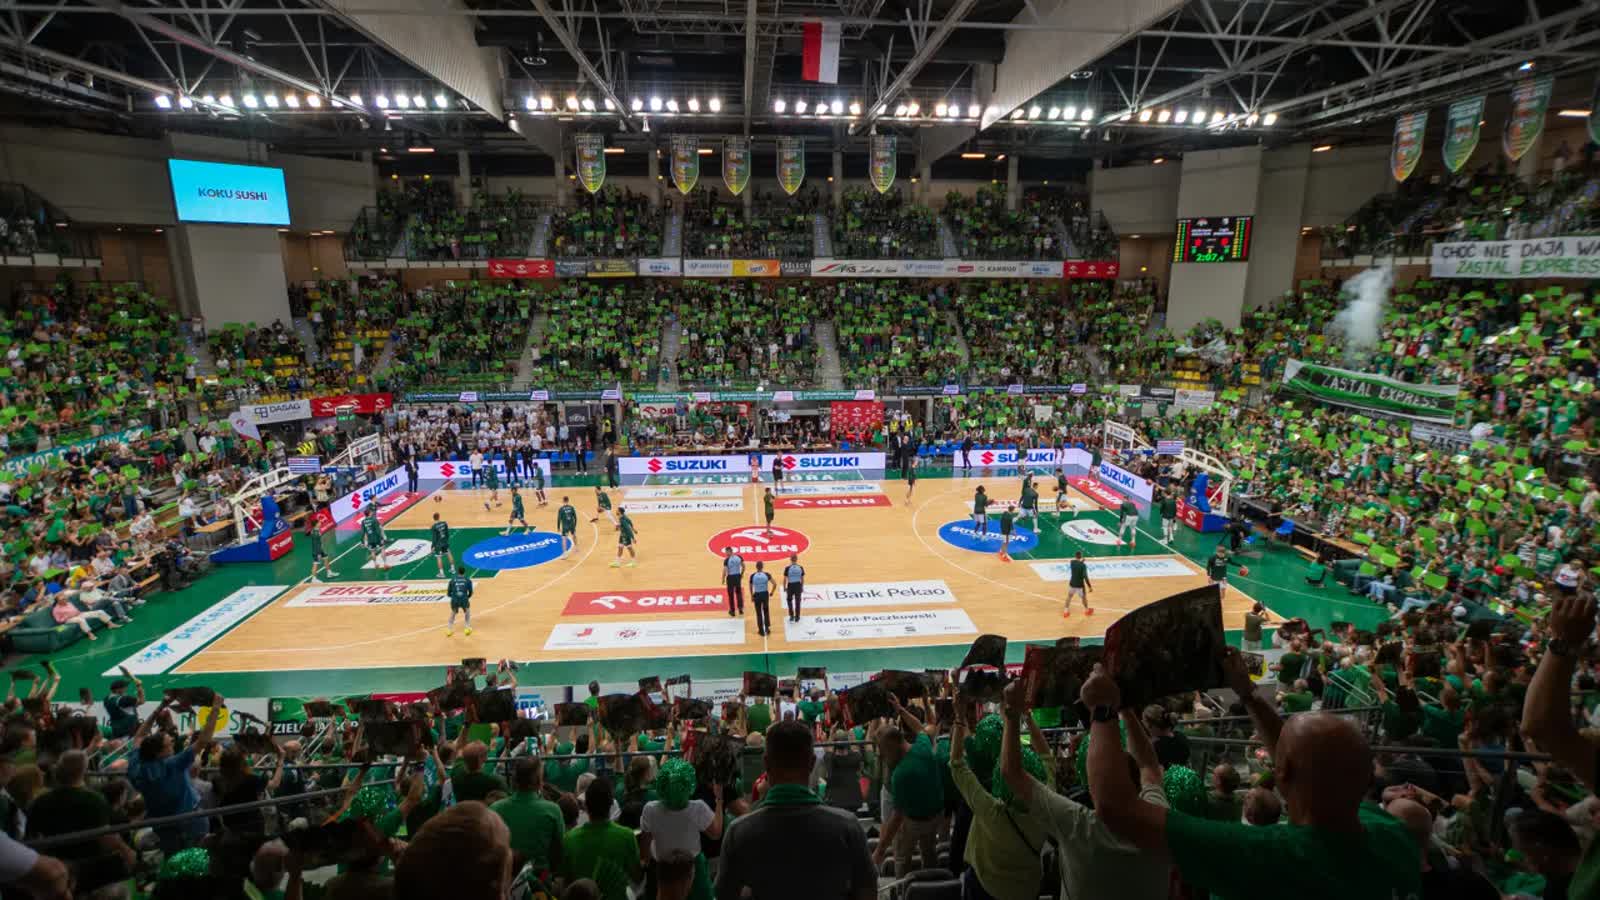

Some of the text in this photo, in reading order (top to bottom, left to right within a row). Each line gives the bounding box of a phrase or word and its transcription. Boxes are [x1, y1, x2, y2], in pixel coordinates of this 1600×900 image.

[198, 187, 268, 200] KOKU SUSHI
[1483, 244, 1512, 258] NIE
[1455, 256, 1600, 274] ZASTAL EXPRESS
[1321, 374, 1440, 409] ZASTAL EXPRESS
[269, 404, 300, 414] DASAG
[799, 456, 859, 468] SUZUKI
[997, 452, 1054, 464] SUUKI
[666, 459, 727, 471] SUZUKI
[1100, 463, 1136, 490] SUZUKI
[362, 475, 399, 503] SUZUKI
[816, 498, 876, 506] ORLEN
[473, 537, 559, 560] Streamsoft
[320, 584, 408, 596] BRICO
[834, 585, 946, 601] Bank Pekao
[637, 594, 723, 607] ORLEN
